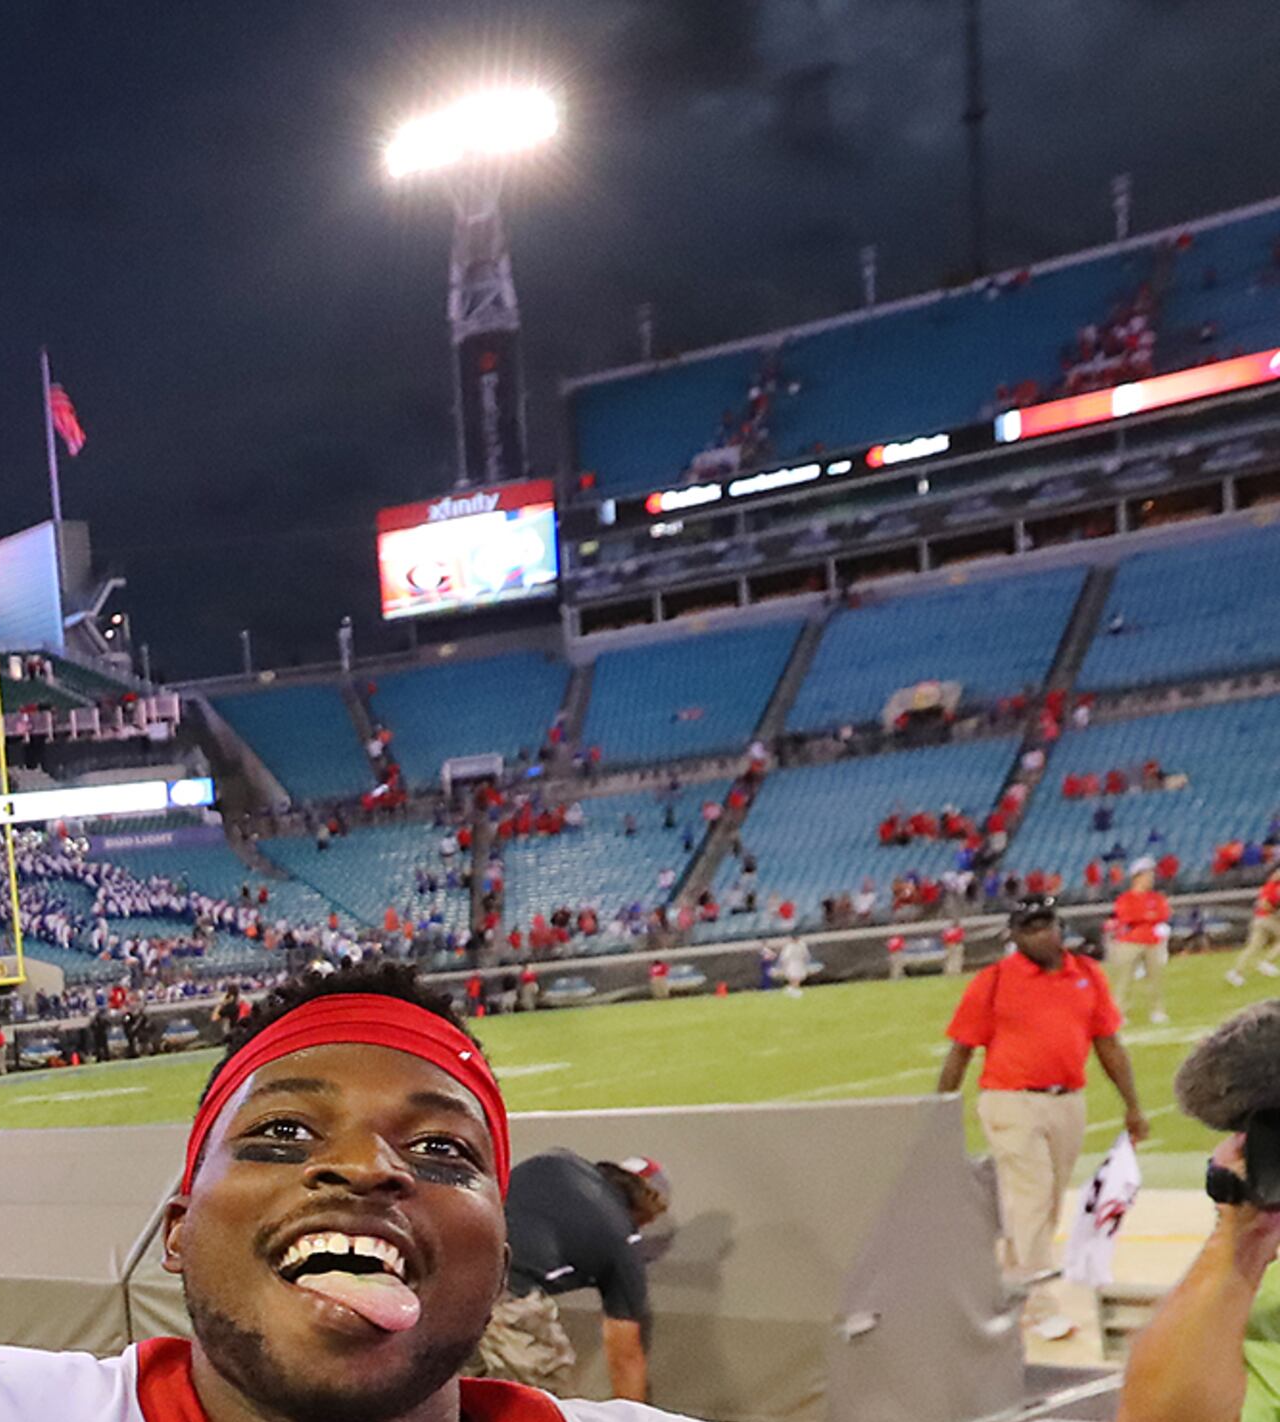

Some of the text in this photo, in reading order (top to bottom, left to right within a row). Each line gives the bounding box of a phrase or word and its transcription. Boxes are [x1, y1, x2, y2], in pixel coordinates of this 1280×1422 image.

[428, 491, 500, 522] xfinity
[104, 832, 174, 849] BUD LIGHT
